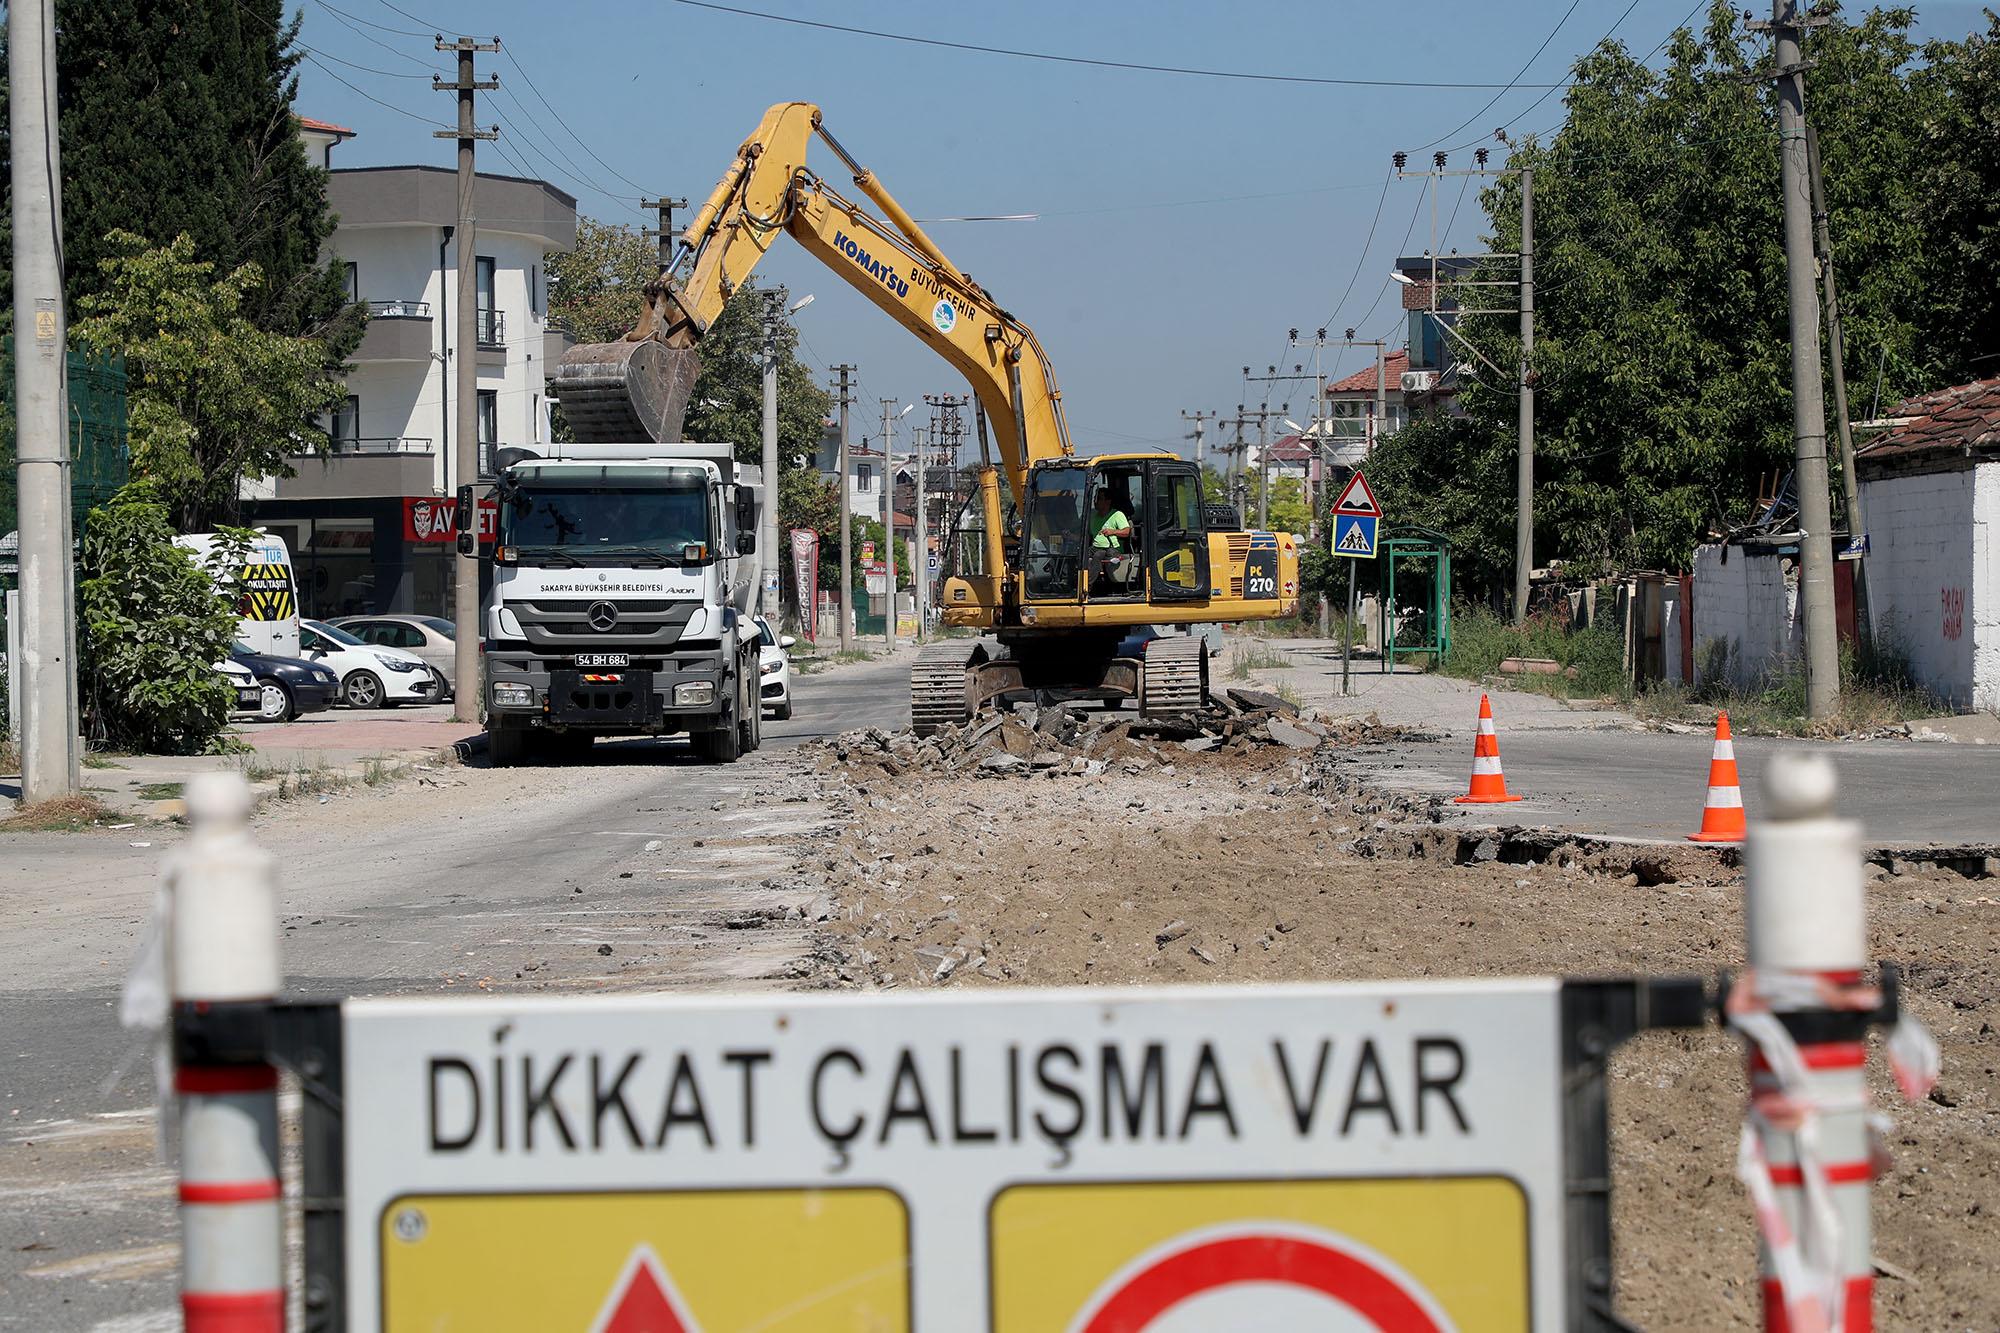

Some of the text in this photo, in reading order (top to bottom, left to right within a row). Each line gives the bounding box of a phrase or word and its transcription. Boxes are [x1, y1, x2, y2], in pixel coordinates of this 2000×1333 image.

[833, 230, 910, 298] KOMATSU
[929, 559, 936, 567] D
[1249, 565, 1262, 577] PC
[247, 579, 267, 589] OKUL
[540, 583, 663, 593] SAKARYA BÜYÜKŞEHİR BELEDİYESİ
[1249, 578, 1274, 593] 270
[578, 655, 626, 665] 54 BH 684
[430, 1023, 1470, 1170] DİKKAT ÇALIŞMA VAR
